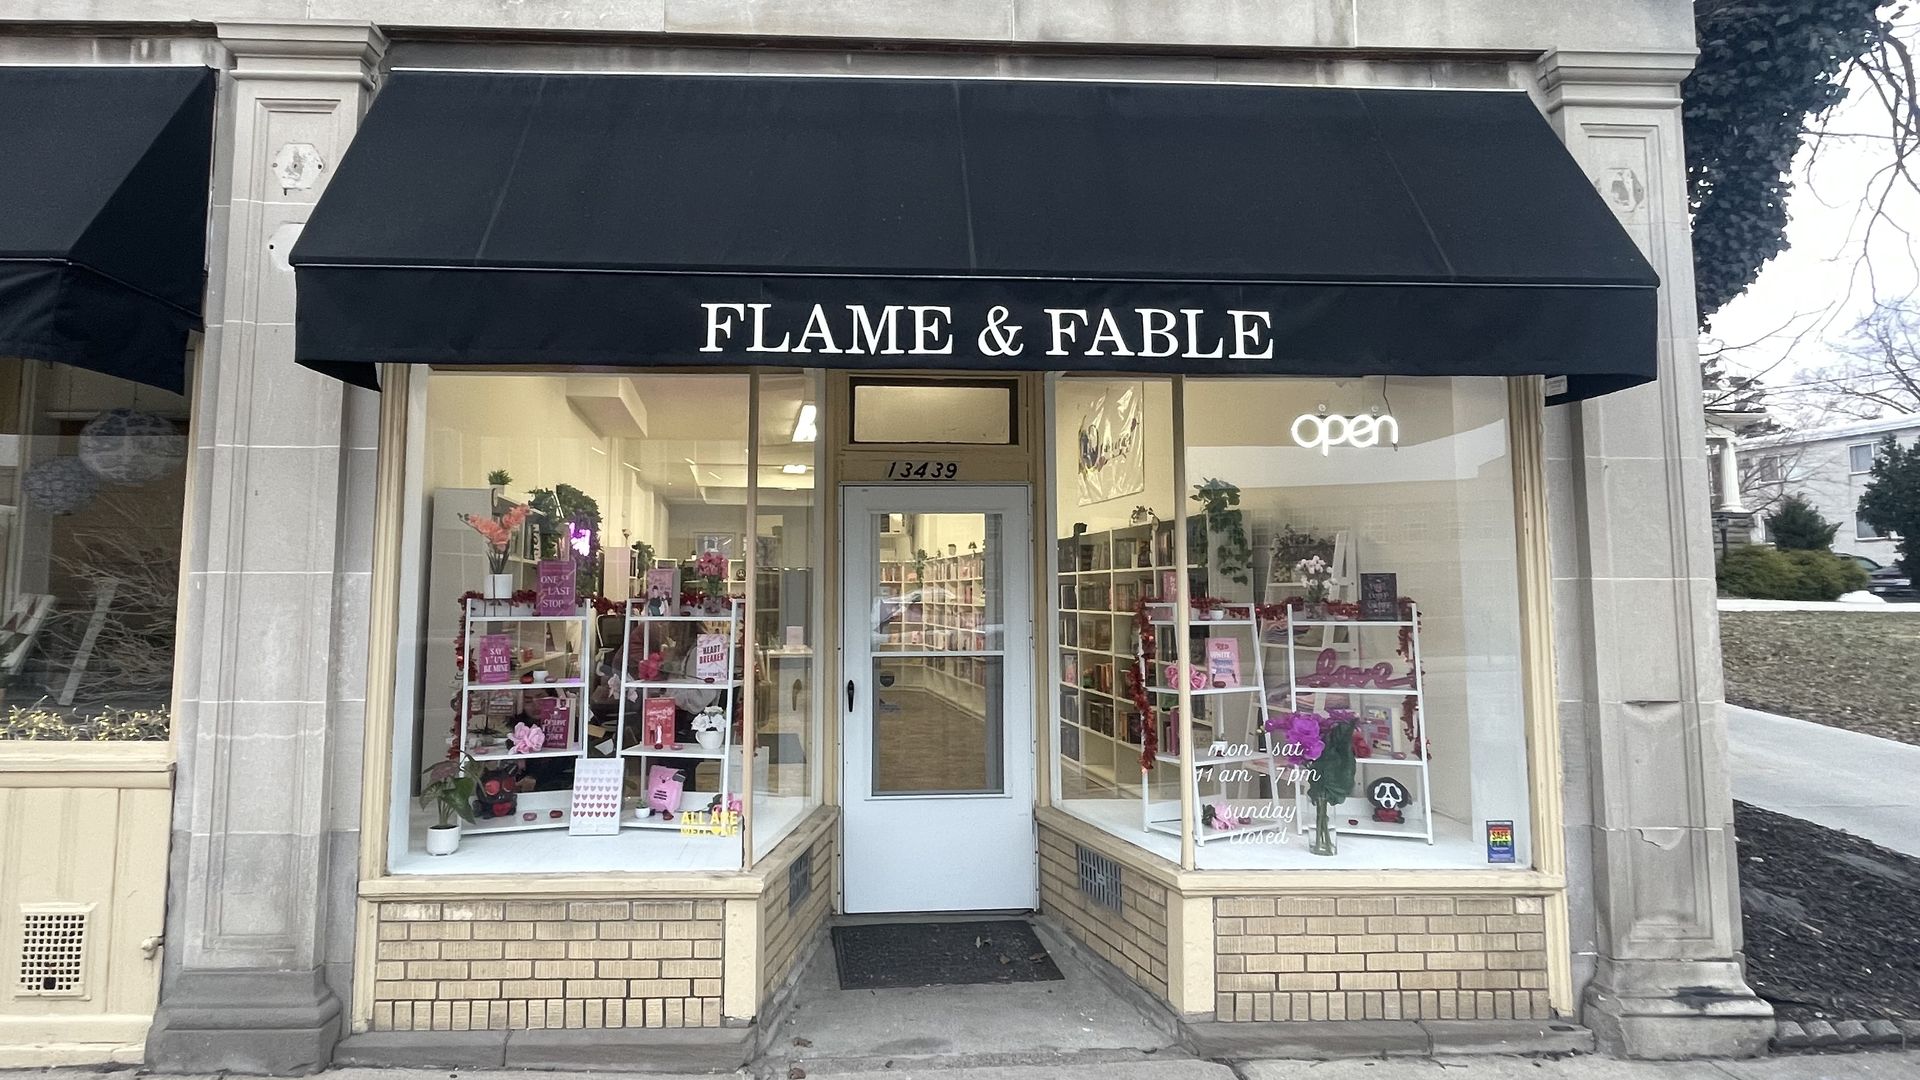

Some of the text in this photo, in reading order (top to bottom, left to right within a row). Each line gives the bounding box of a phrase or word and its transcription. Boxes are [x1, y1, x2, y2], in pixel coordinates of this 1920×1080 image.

[699, 302, 1275, 360] FLAME & FABLE
[1291, 413, 1398, 457] open
[888, 461, 958, 479] 13439
[547, 586, 570, 596] LAST
[542, 599, 564, 608] STOP
[1207, 742, 1253, 757] mon
[1271, 741, 1304, 757] sat
[1218, 767, 1253, 782] am
[1275, 766, 1285, 784] 7
[1287, 767, 1321, 786] pm
[1223, 801, 1297, 823] sunday
[1229, 827, 1289, 845] closed
[1492, 831, 1509, 840] SAFE
